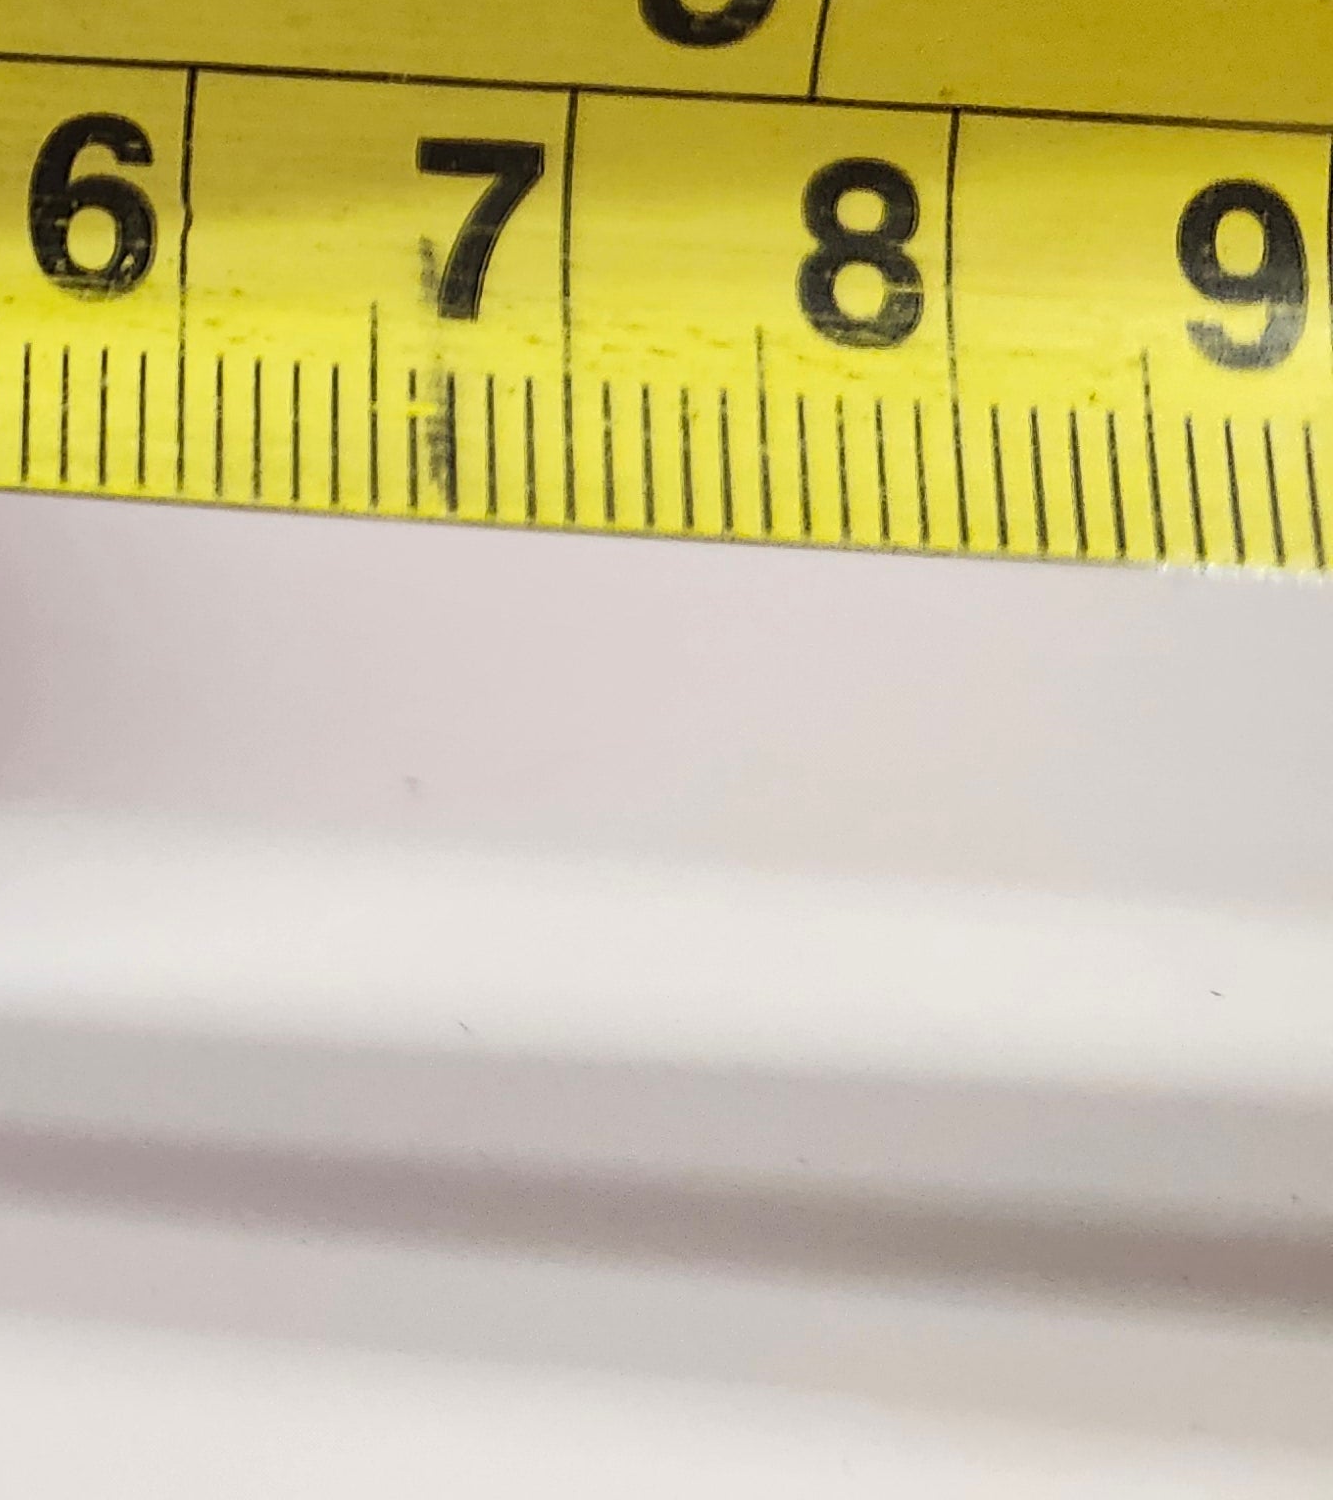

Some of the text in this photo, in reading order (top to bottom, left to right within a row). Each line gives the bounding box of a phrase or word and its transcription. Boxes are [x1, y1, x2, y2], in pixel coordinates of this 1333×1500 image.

[27, 111, 158, 299] 6
[415, 137, 546, 323] 7
[795, 156, 925, 349] 8
[1175, 177, 1309, 371] 9
